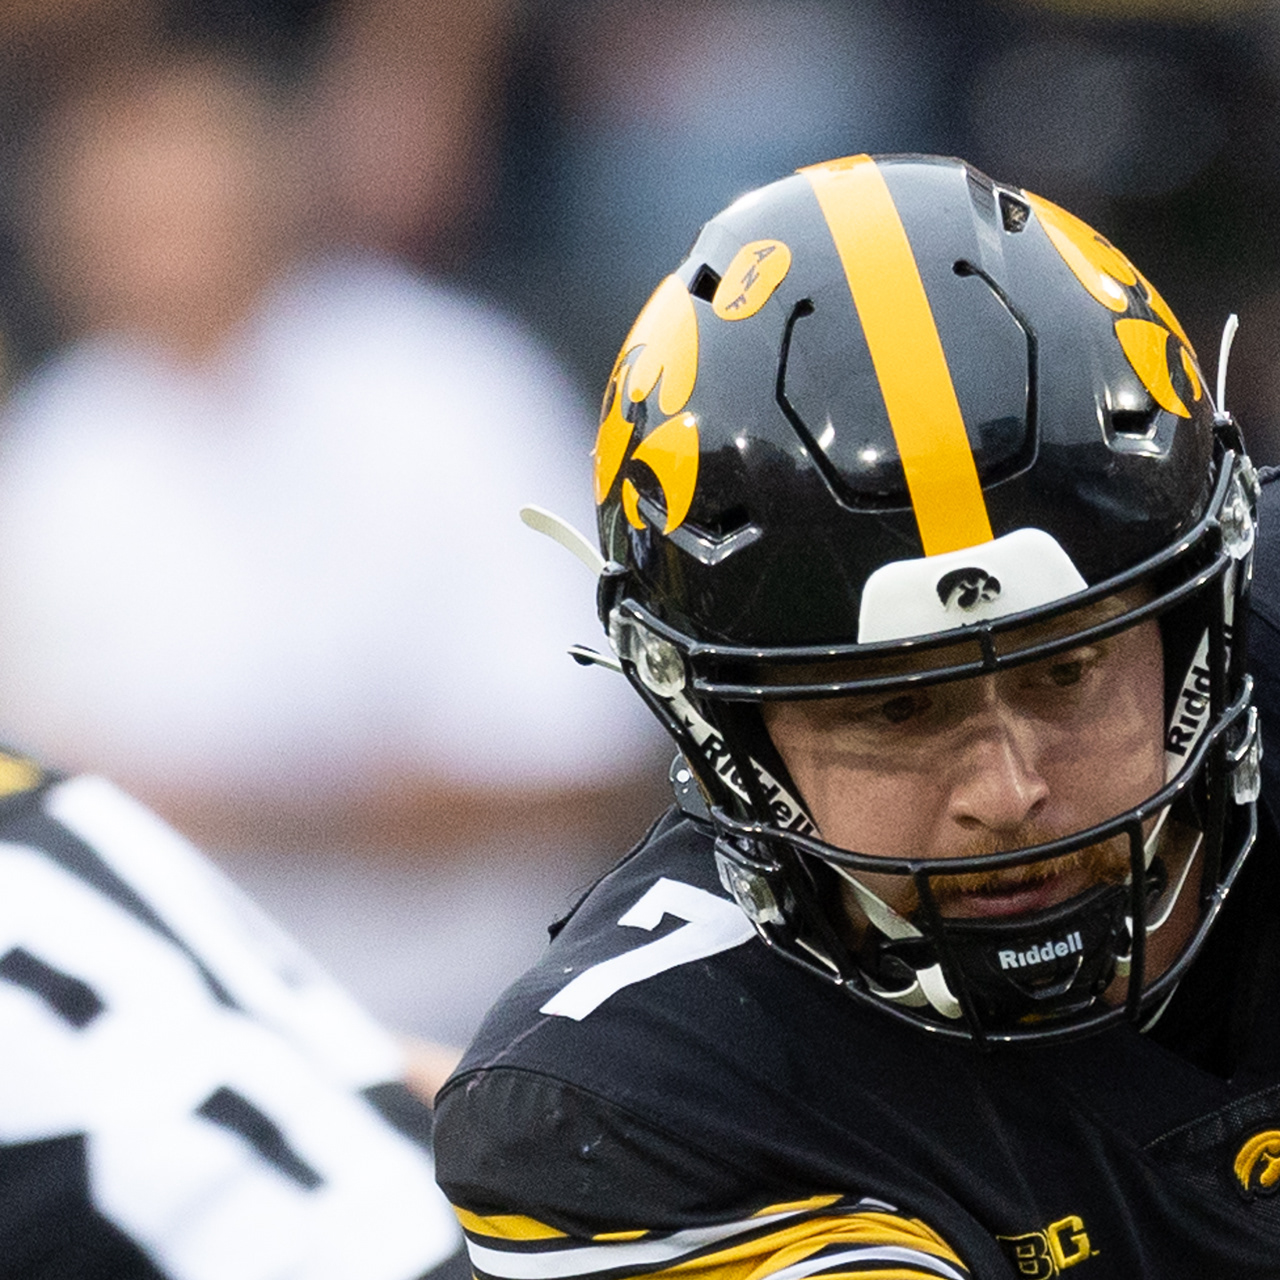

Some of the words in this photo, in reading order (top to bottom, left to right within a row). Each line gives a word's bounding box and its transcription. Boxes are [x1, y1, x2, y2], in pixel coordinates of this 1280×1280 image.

[725, 245, 777, 311] ANF
[538, 876, 758, 1022] 7
[998, 931, 1083, 970] Riddell
